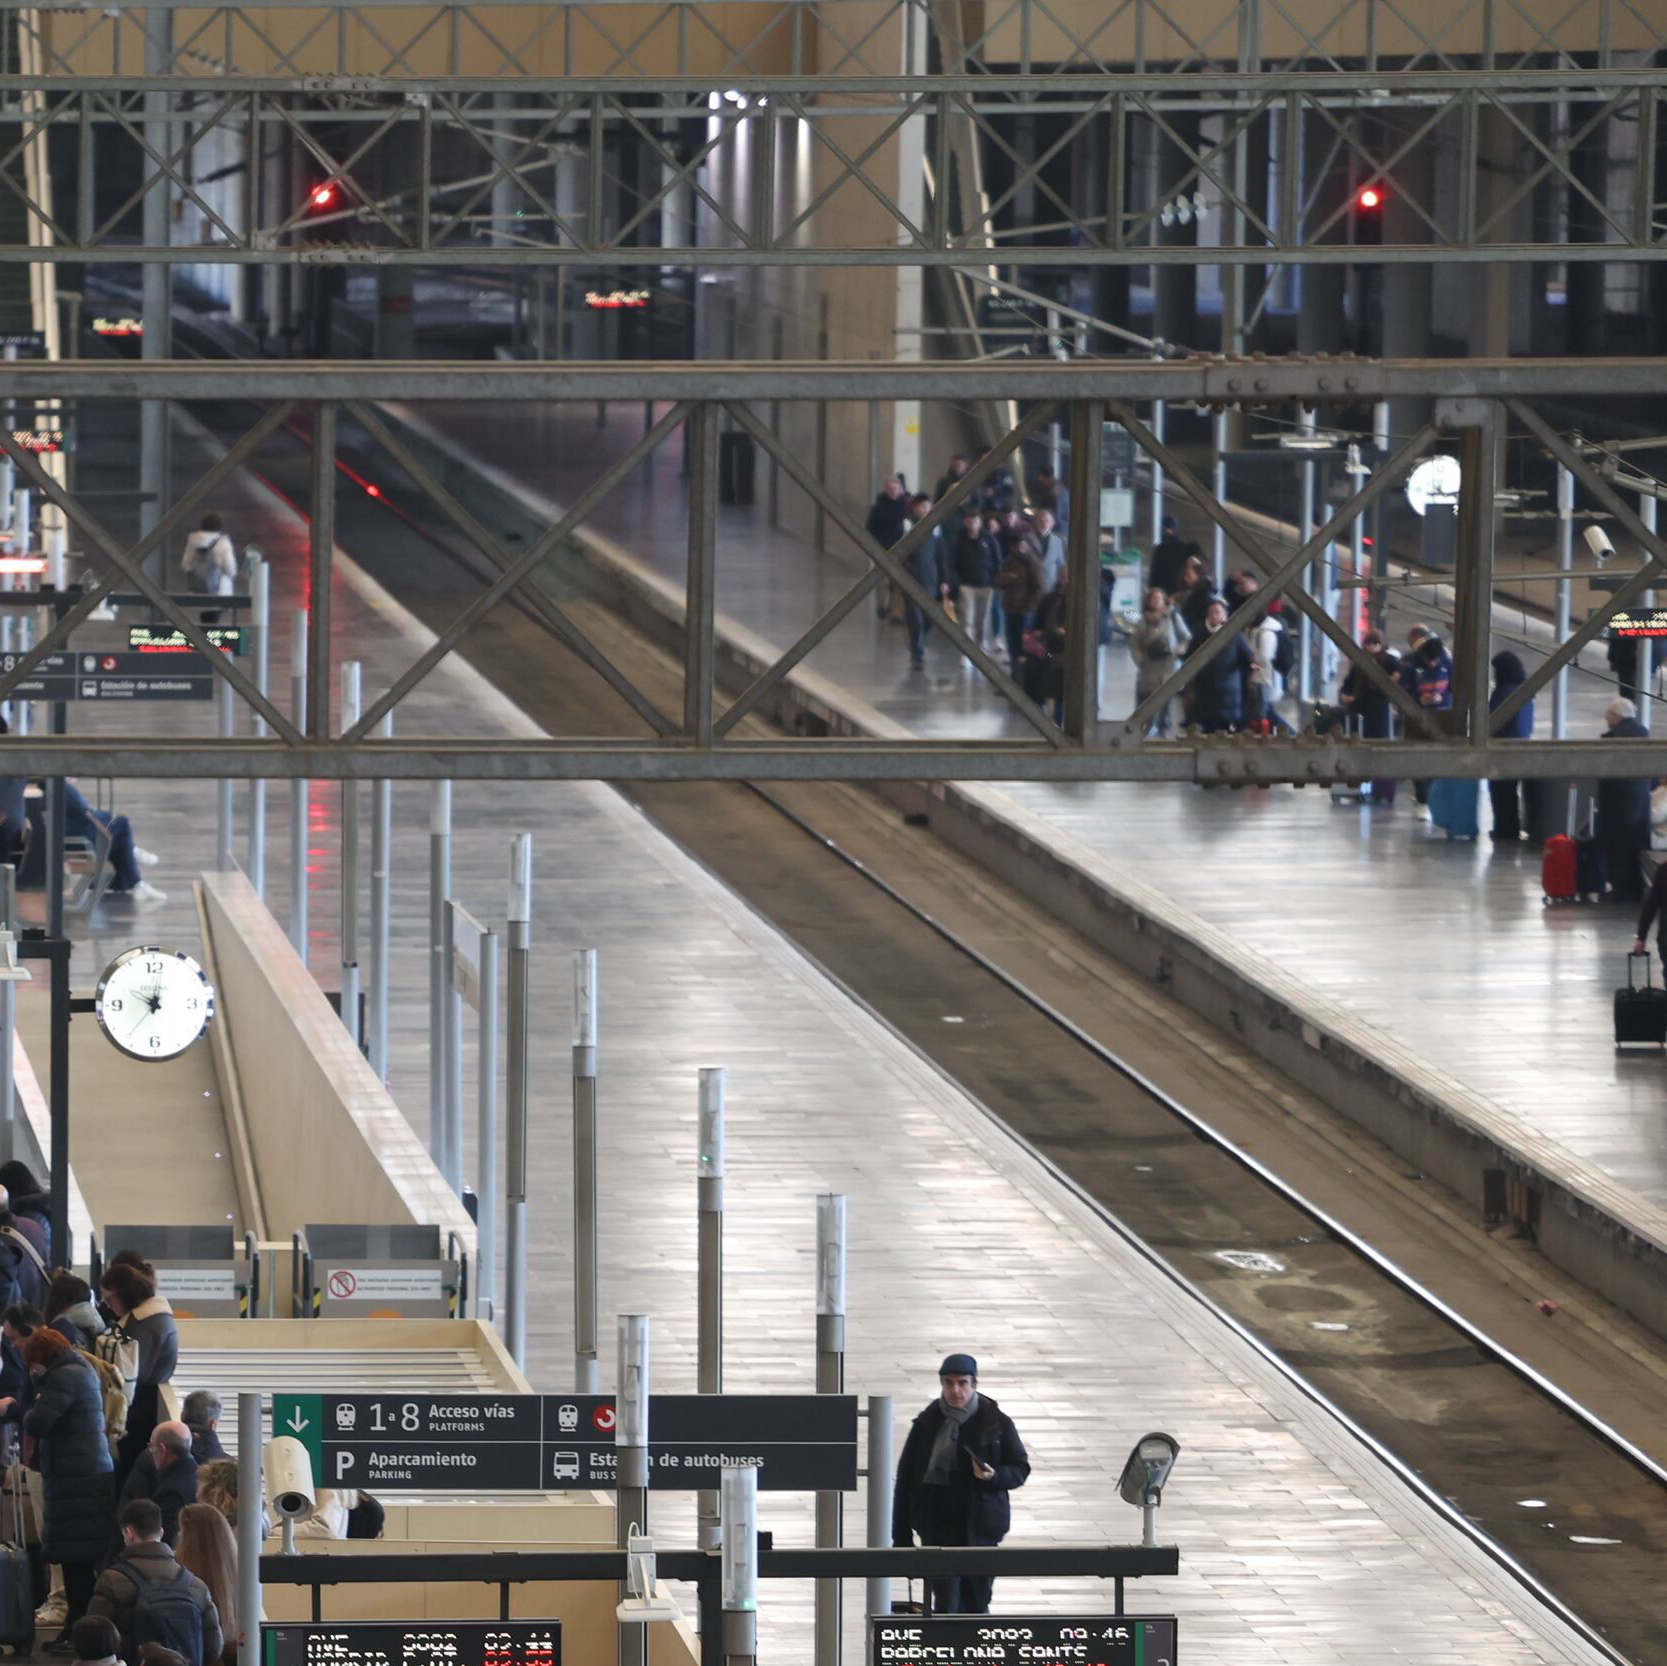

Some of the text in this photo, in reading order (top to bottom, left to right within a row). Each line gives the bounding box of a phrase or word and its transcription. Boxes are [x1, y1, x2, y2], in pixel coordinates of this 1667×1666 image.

[146, 961, 164, 974] 12
[111, 999, 123, 1012] 9
[186, 997, 198, 1010] 3
[149, 1035, 161, 1049] 6
[369, 1402, 387, 1432] 1
[400, 1402, 420, 1432] 8
[428, 1403, 516, 1419] Acceso vías
[428, 1421, 485, 1432] PLATFORMS
[335, 1450, 356, 1480] P
[368, 1451, 477, 1469] Aparcamiento
[589, 1451, 765, 1469] Estan de autobuses
[368, 1469, 412, 1480] PARKING
[589, 1470, 610, 1481] BUS
